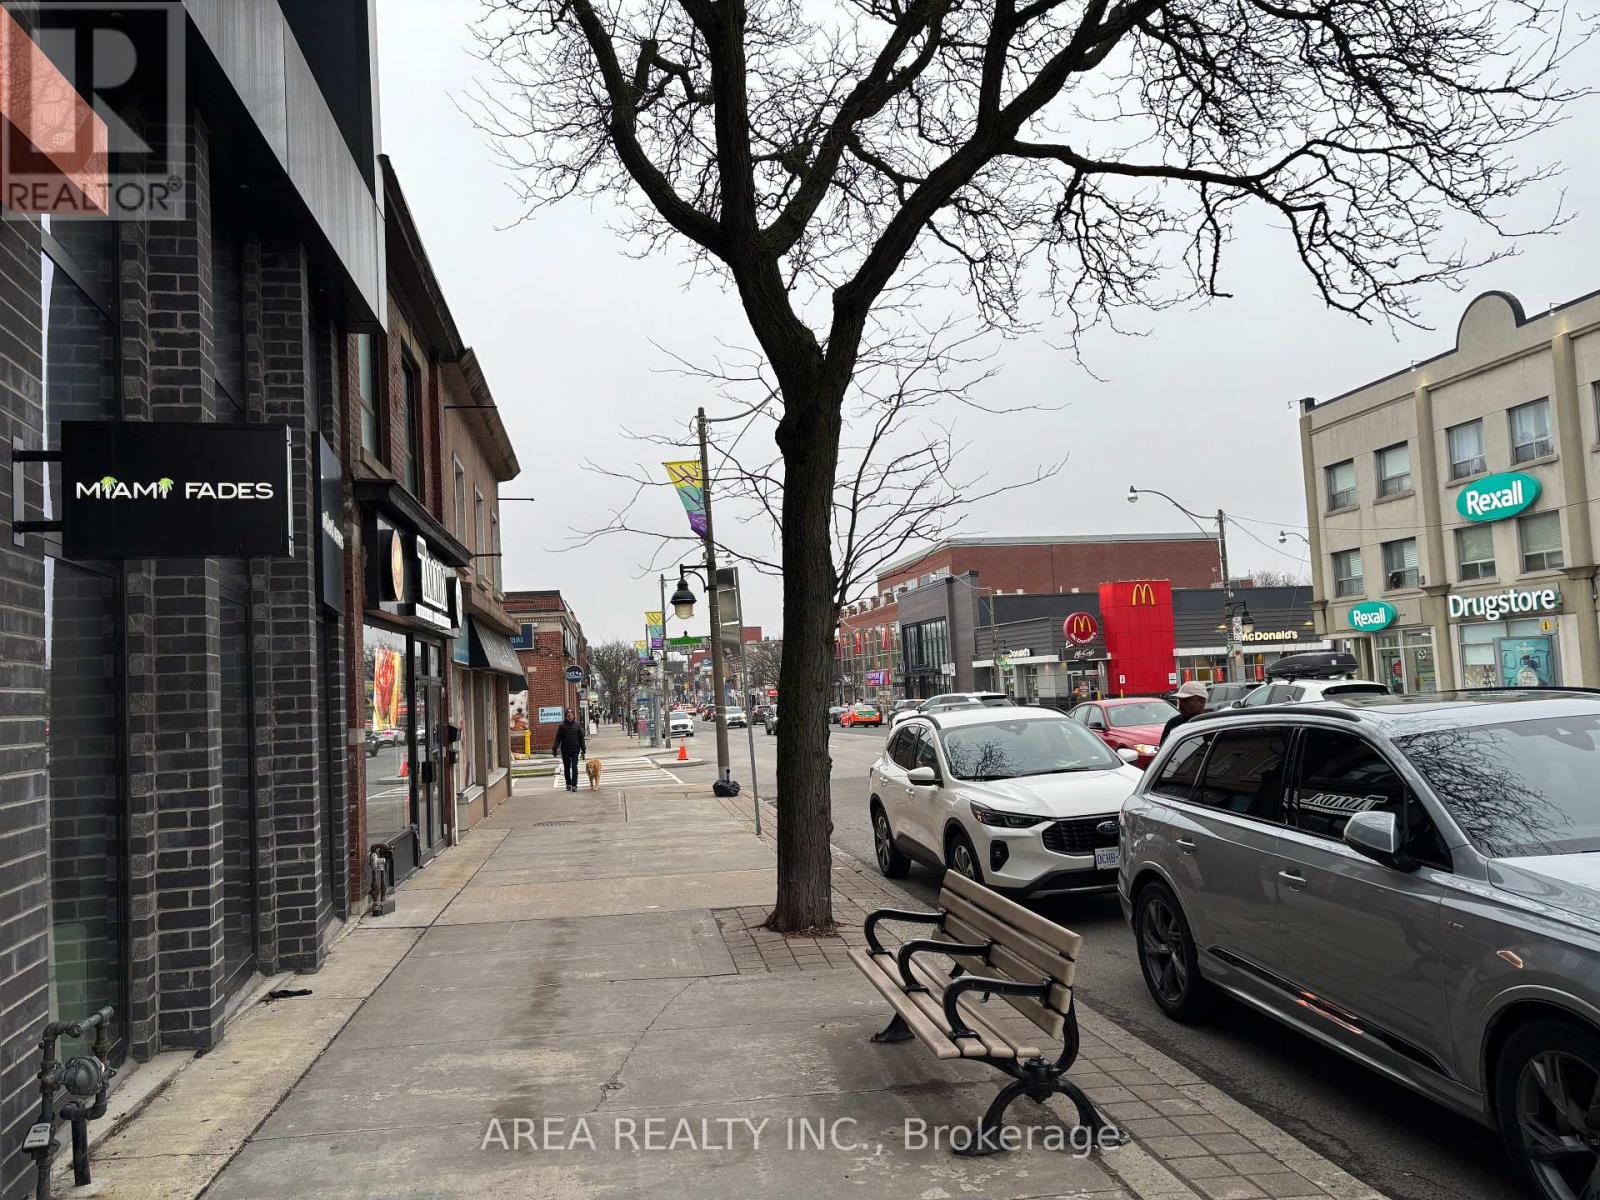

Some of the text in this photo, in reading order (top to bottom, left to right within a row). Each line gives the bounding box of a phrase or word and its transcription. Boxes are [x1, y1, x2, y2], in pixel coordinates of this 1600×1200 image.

[76, 476, 274, 499] MIAMI FADES
[1466, 480, 1523, 516] Rexall
[1353, 607, 1386, 627] Rexall
[1448, 589, 1556, 620] Drugstore
